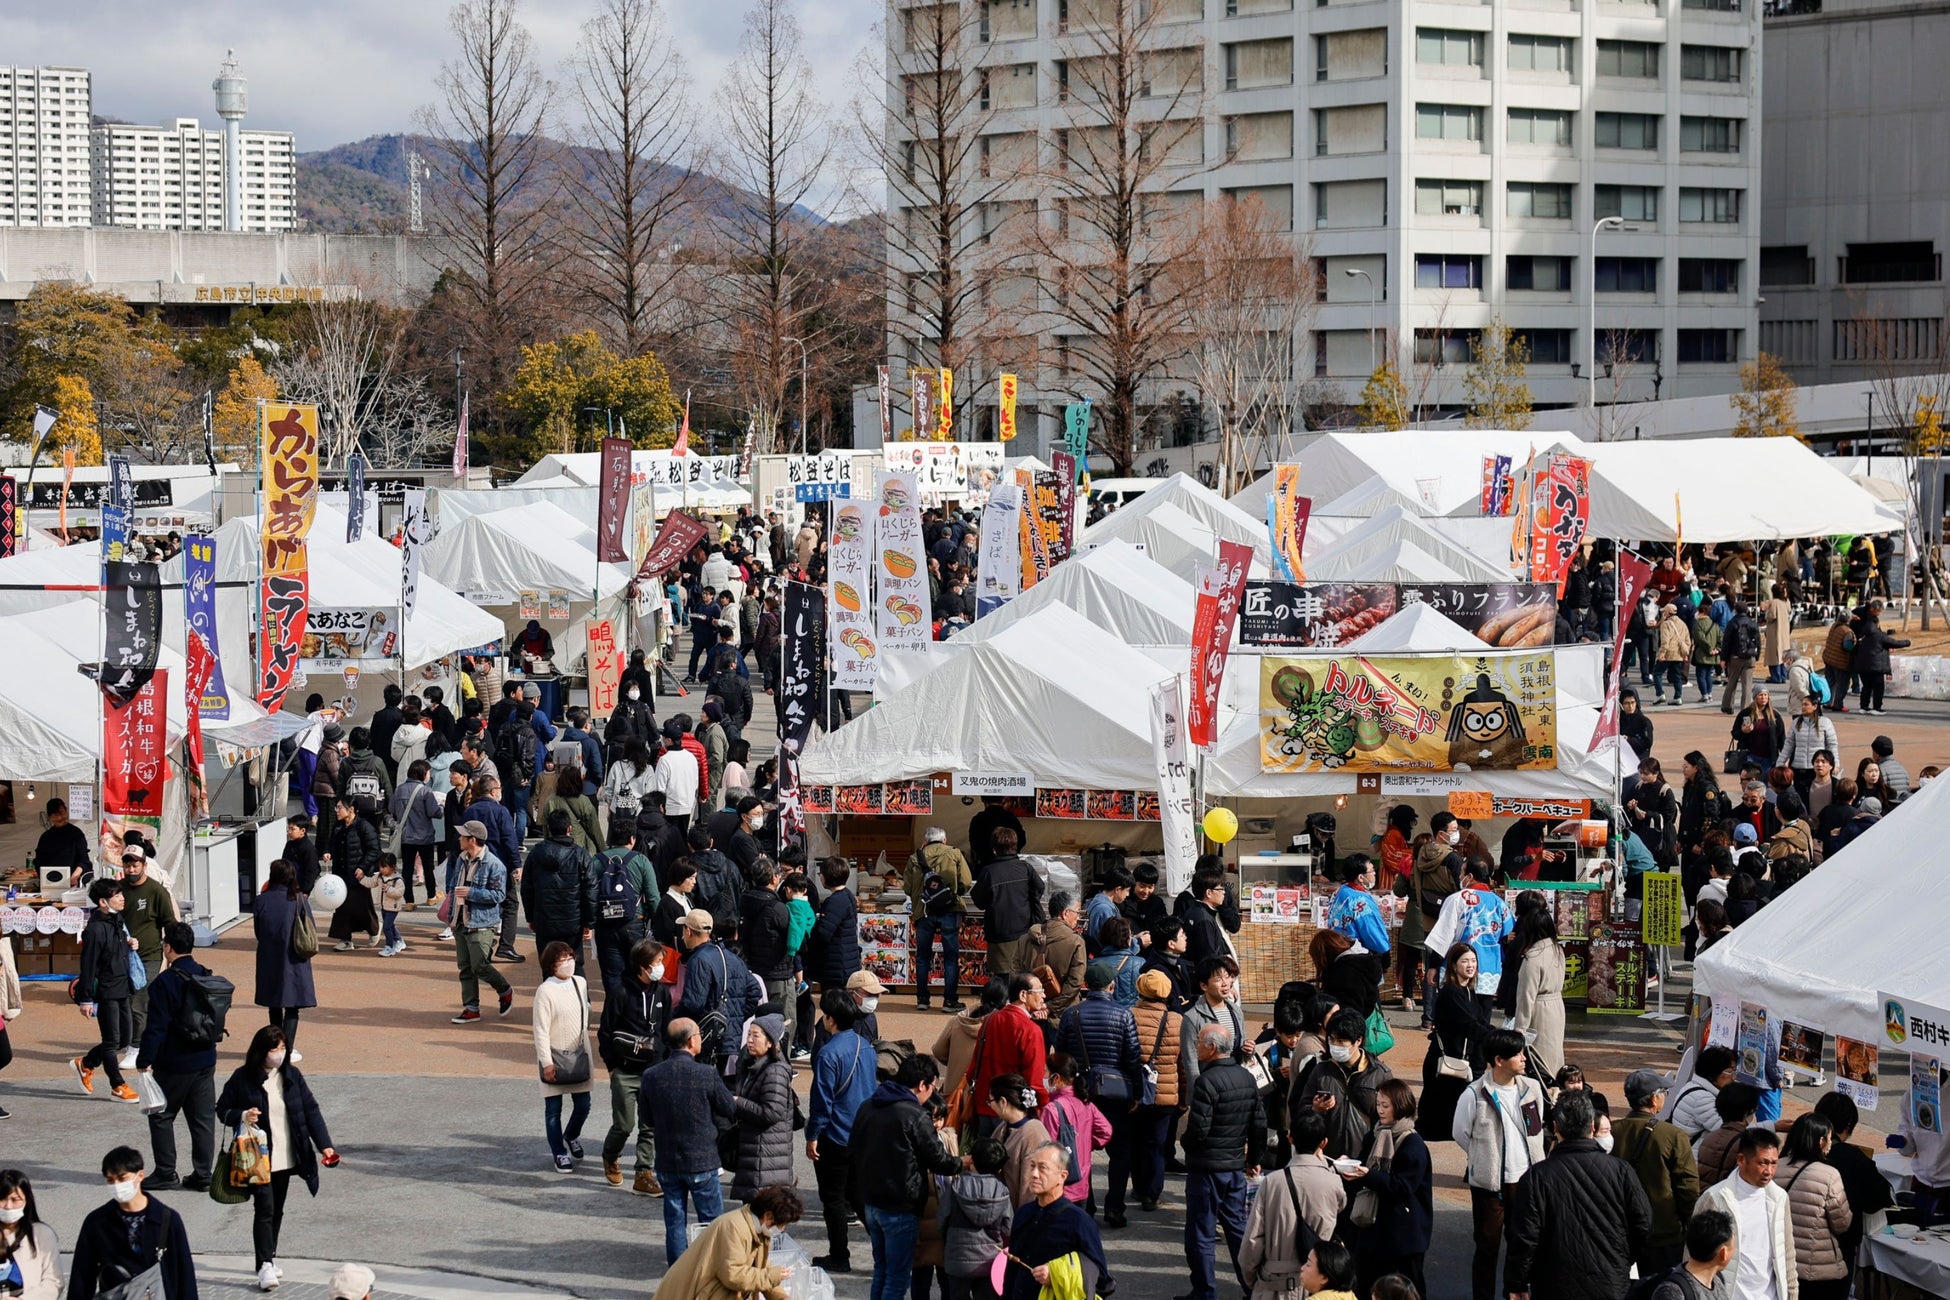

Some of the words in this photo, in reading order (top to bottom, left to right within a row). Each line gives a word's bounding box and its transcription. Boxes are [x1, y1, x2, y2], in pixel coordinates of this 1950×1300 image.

[1001, 380, 1015, 438] ラーメン
[268, 409, 315, 571] からあげ
[669, 459, 741, 483] 松笠そば
[789, 461, 850, 483] 松笠そば
[881, 530, 918, 541] バーガー
[1536, 537, 1547, 576] コロッ
[885, 578, 921, 589] 調理パン
[262, 577, 304, 709] ラーメン
[886, 627, 924, 638] 菓子パン
[590, 621, 617, 710] 鴨そば
[1325, 660, 1441, 733] トルネード
[1520, 662, 1535, 717] 須我神社
[1536, 660, 1552, 726] 島根・大東
[118, 704, 134, 783] イスバーガー
[887, 788, 931, 806] シカ焼肉
[934, 779, 948, 788] G-4
[1362, 778, 1376, 787] G-3
[1384, 776, 1463, 786] 奥出雲和牛フードシャトル
[1140, 796, 1160, 811] ワニ
[1614, 962, 1626, 1007] ステーキ
[1627, 950, 1638, 1007] トルネード
[1910, 1016, 1949, 1046] 西村キ
